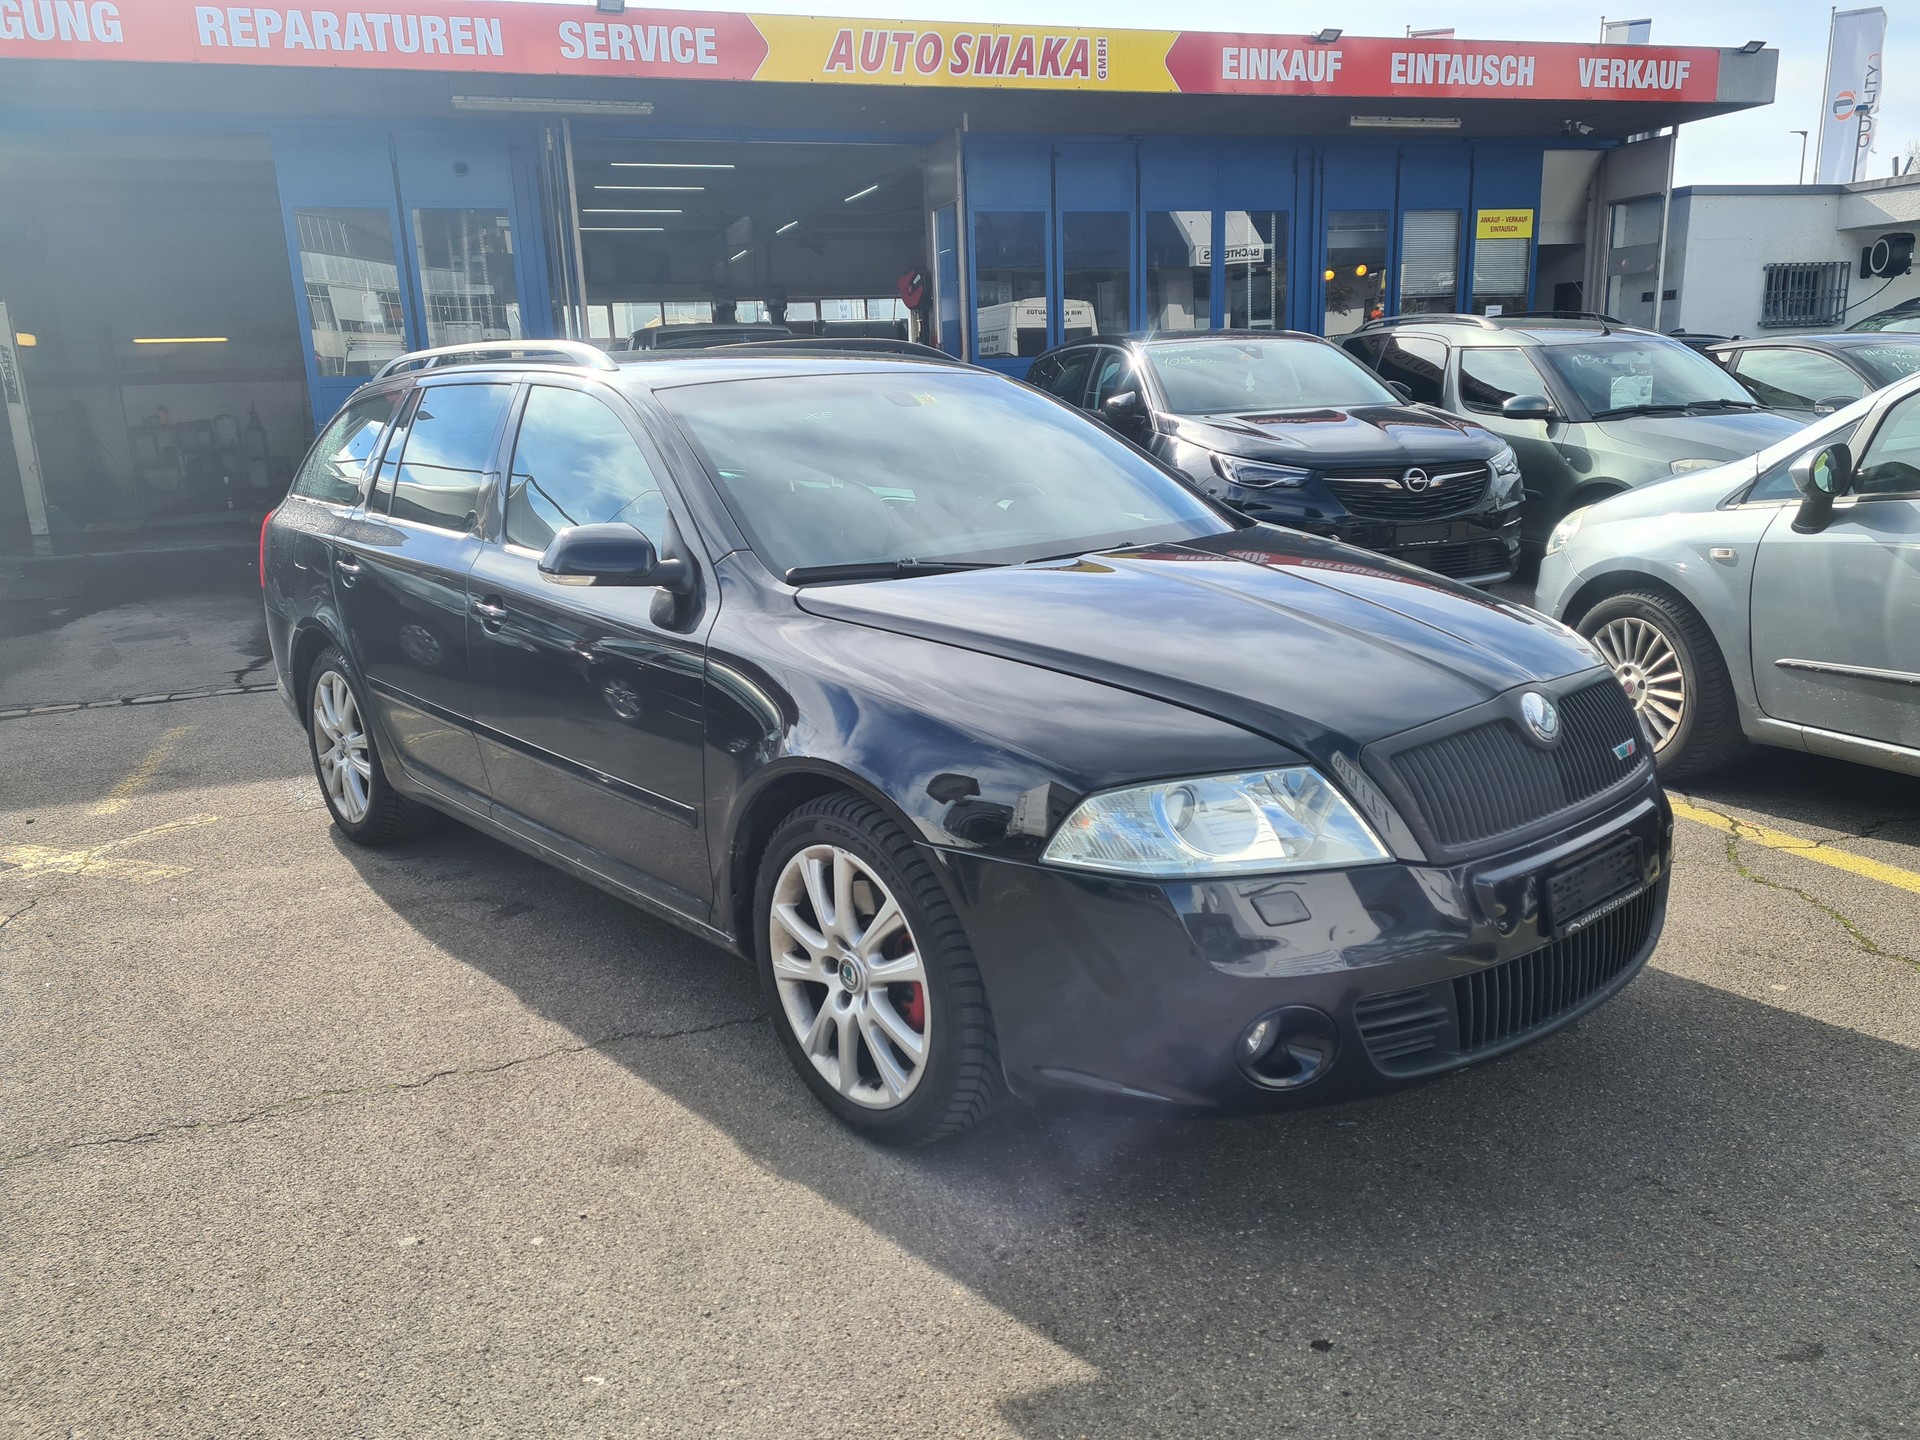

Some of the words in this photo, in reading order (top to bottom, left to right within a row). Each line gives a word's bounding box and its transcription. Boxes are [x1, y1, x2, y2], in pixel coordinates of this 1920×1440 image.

[0, 0, 124, 43] GUNG
[195, 5, 505, 56] REPARATUREN
[558, 20, 718, 65] SERVICE
[822, 27, 945, 76] AUTO
[948, 32, 1091, 80] SMAKA
[1097, 37, 1108, 80] GMBH
[1222, 47, 1343, 82] EINKAUF
[1390, 52, 1536, 86] EINTAUSCH
[1578, 57, 1691, 90] VERKAUF
[1580, 908, 1602, 926] GARAGE
